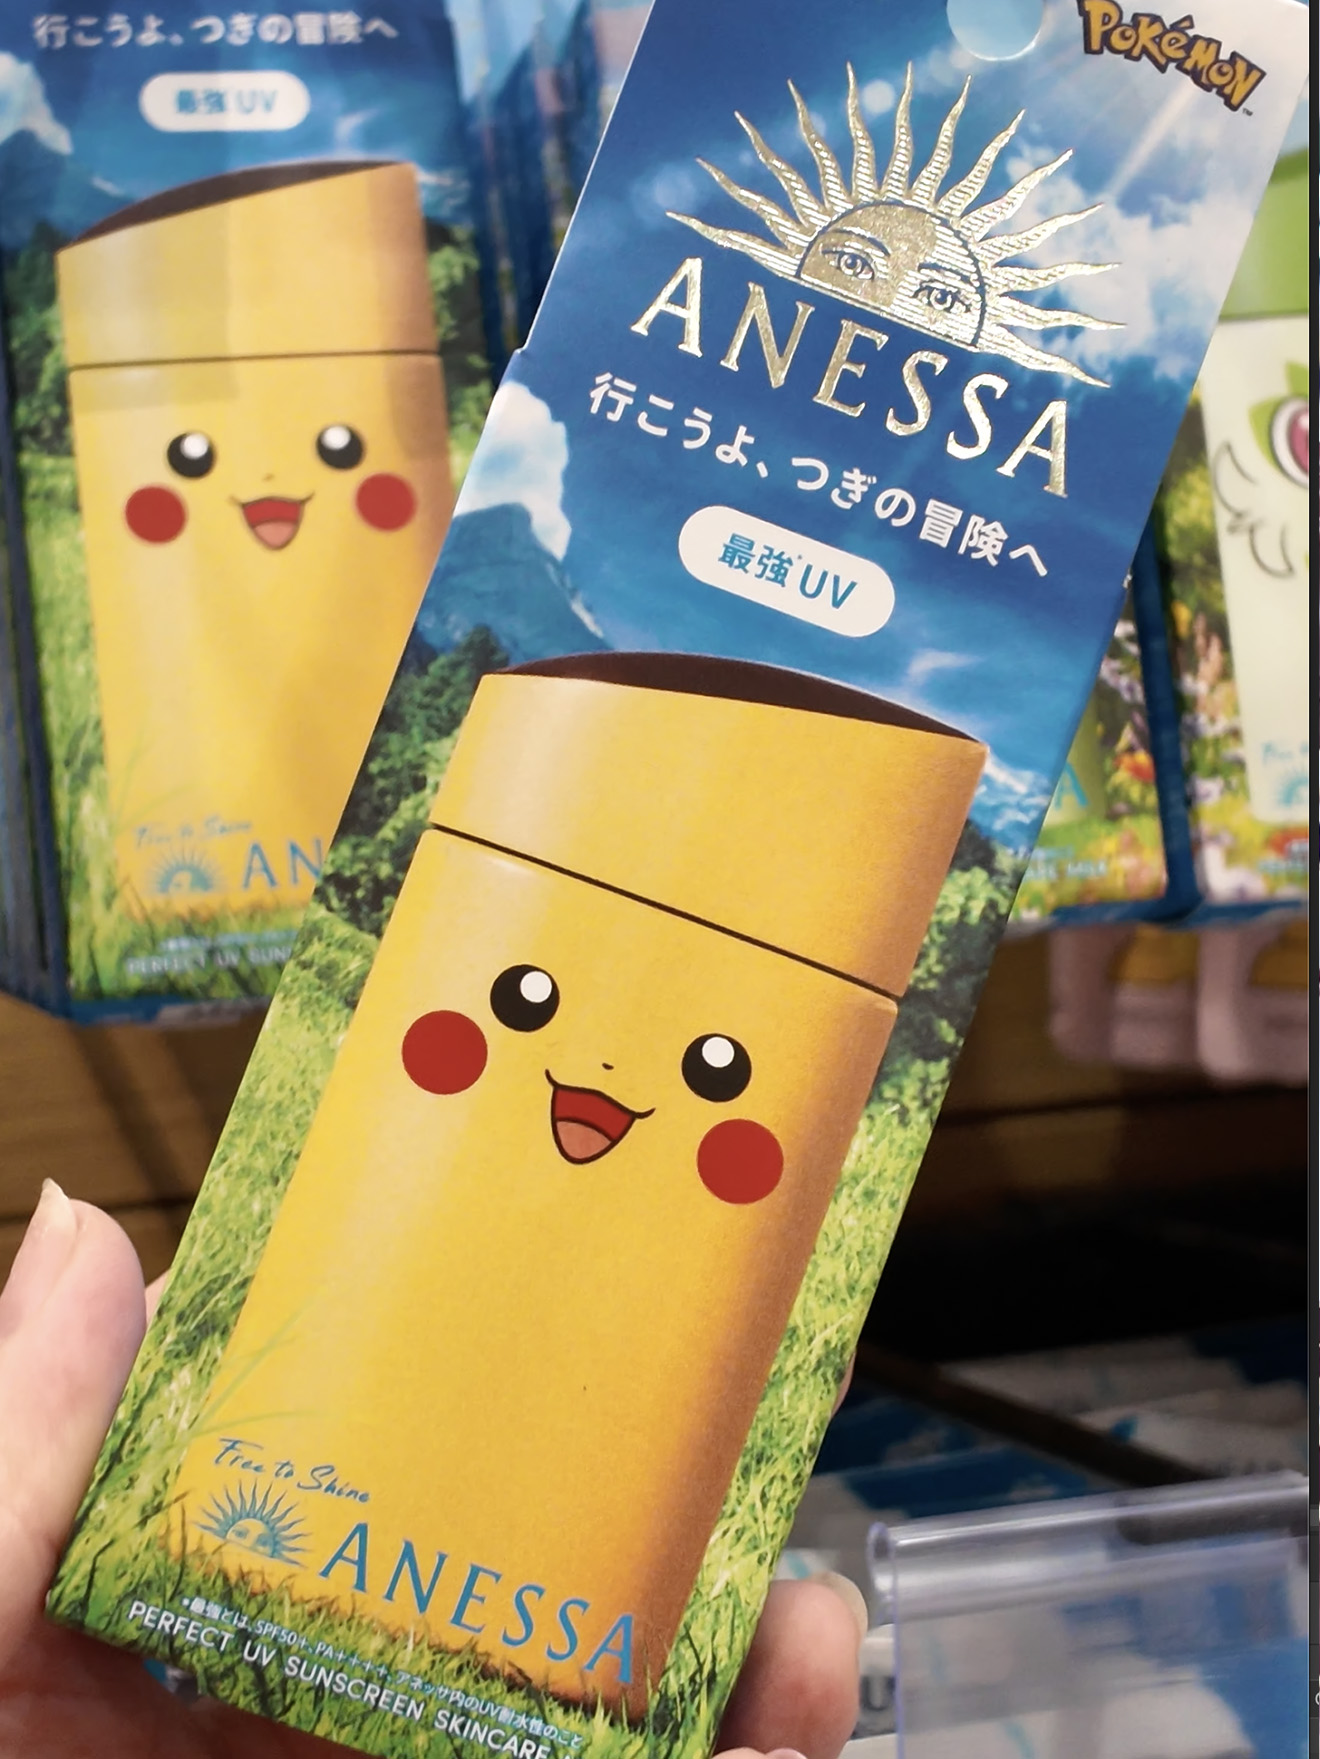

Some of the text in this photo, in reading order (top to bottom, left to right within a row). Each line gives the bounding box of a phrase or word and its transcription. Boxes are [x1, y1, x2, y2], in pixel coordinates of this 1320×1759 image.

[630, 256, 1068, 498] ANESSA
[589, 371, 1048, 578] 行こうよ、つぎの冒険へ
[214, 1437, 372, 1504] Free to Shine
[127, 1600, 553, 1759] PERFECT UV SUNSCREEN SKINCARE
[318, 1521, 635, 1685] ANESSA
